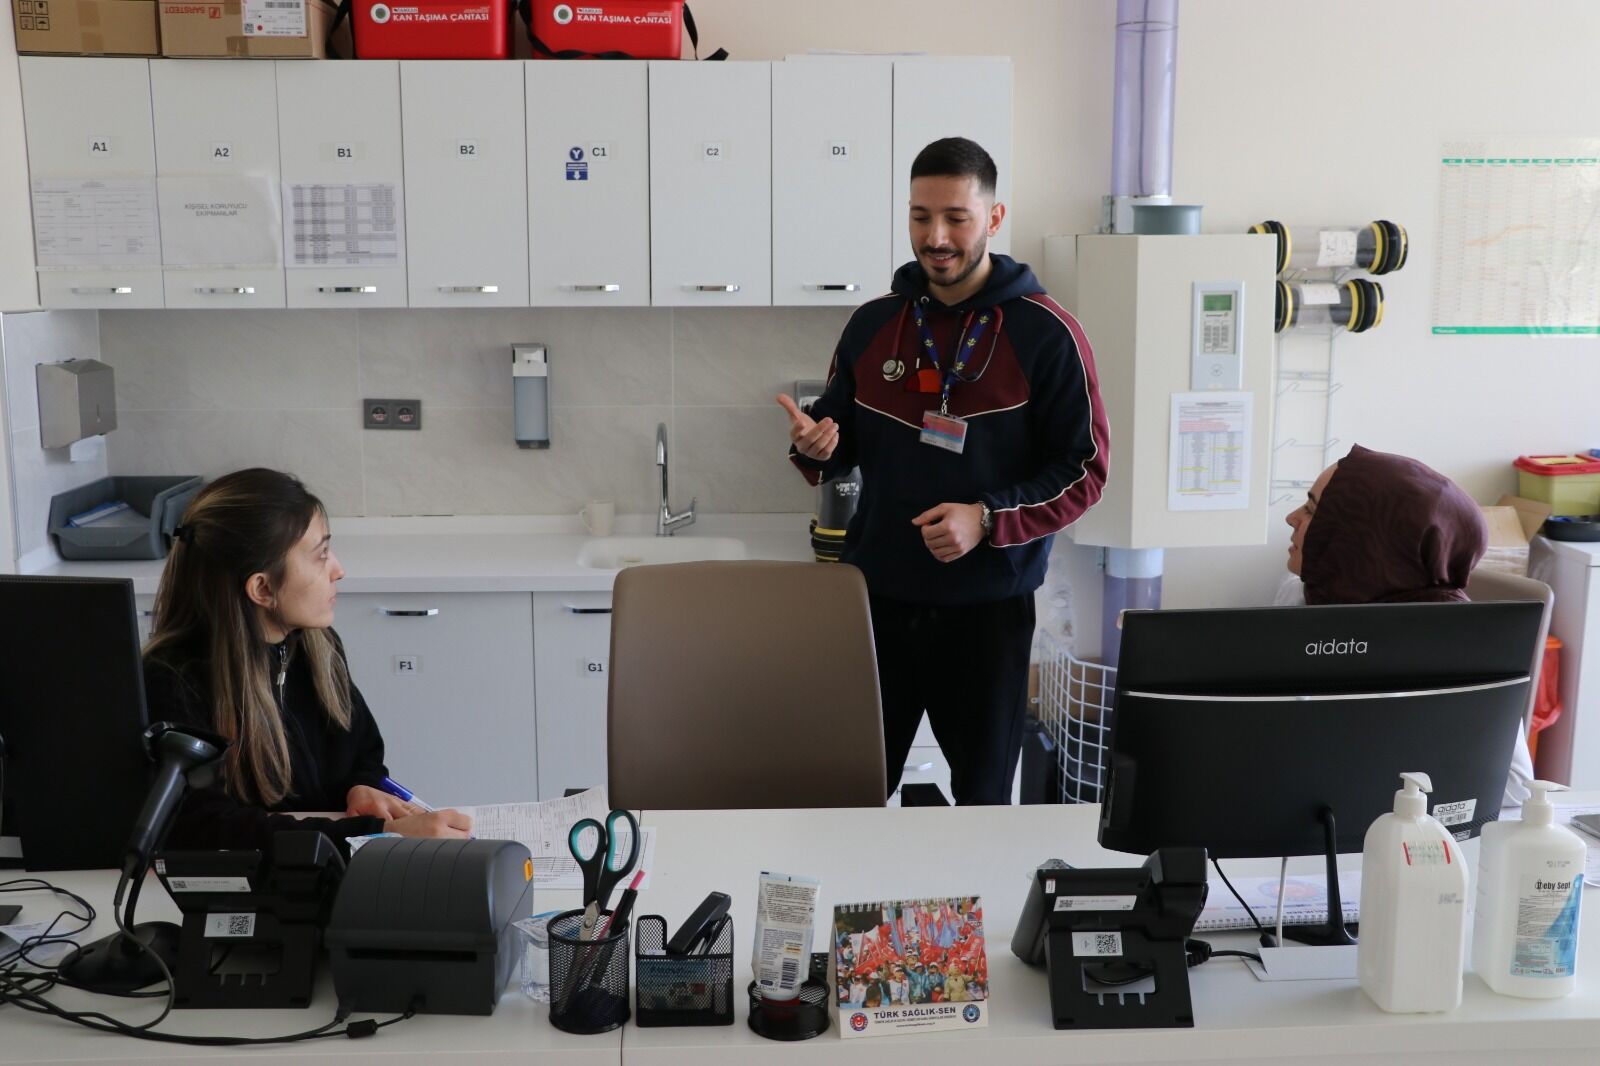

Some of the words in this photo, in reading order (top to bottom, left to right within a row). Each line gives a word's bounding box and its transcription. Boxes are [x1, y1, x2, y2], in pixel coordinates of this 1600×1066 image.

[415, 14, 448, 22] TAŞIMA
[450, 13, 489, 21] ÇANTASI
[577, 14, 597, 22] KAN
[599, 15, 631, 24] TAŞIMA
[92, 142, 108, 152] A1
[214, 147, 230, 157] A2
[460, 145, 475, 155] B2
[592, 147, 607, 157] C1
[706, 148, 720, 156] C2
[832, 146, 847, 156] D1
[337, 148, 353, 158] B1
[1305, 638, 1368, 655] aidata
[399, 661, 414, 671] F1
[588, 662, 604, 672] G1
[1437, 802, 1466, 812] aidata
[874, 1010, 900, 1019] TÜRK
[902, 1006, 956, 1017] SAĞLIK-SEN
